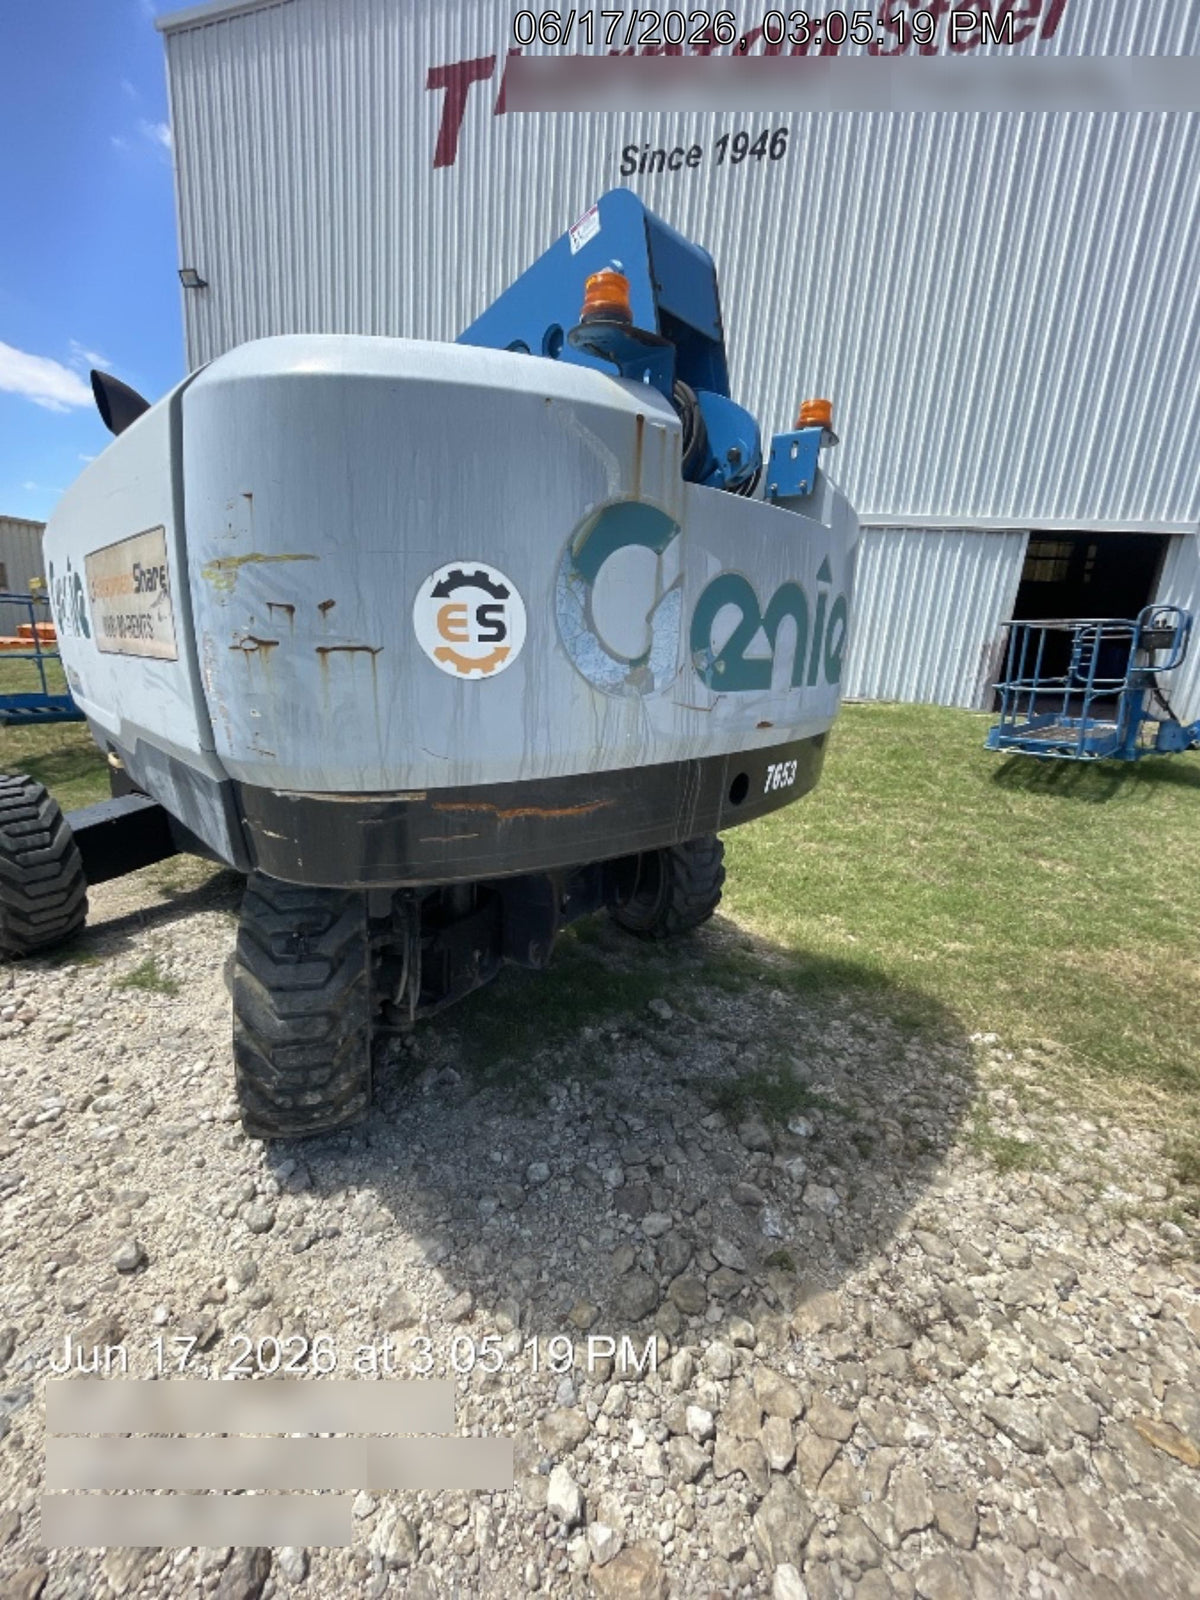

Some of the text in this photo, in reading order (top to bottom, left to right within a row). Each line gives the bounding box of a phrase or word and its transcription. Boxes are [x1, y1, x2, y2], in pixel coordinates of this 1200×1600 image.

[620, 127, 788, 177] Since 1946
[556, 501, 847, 698] Genie
[437, 603, 507, 643] ES
[763, 759, 798, 794] 7653
